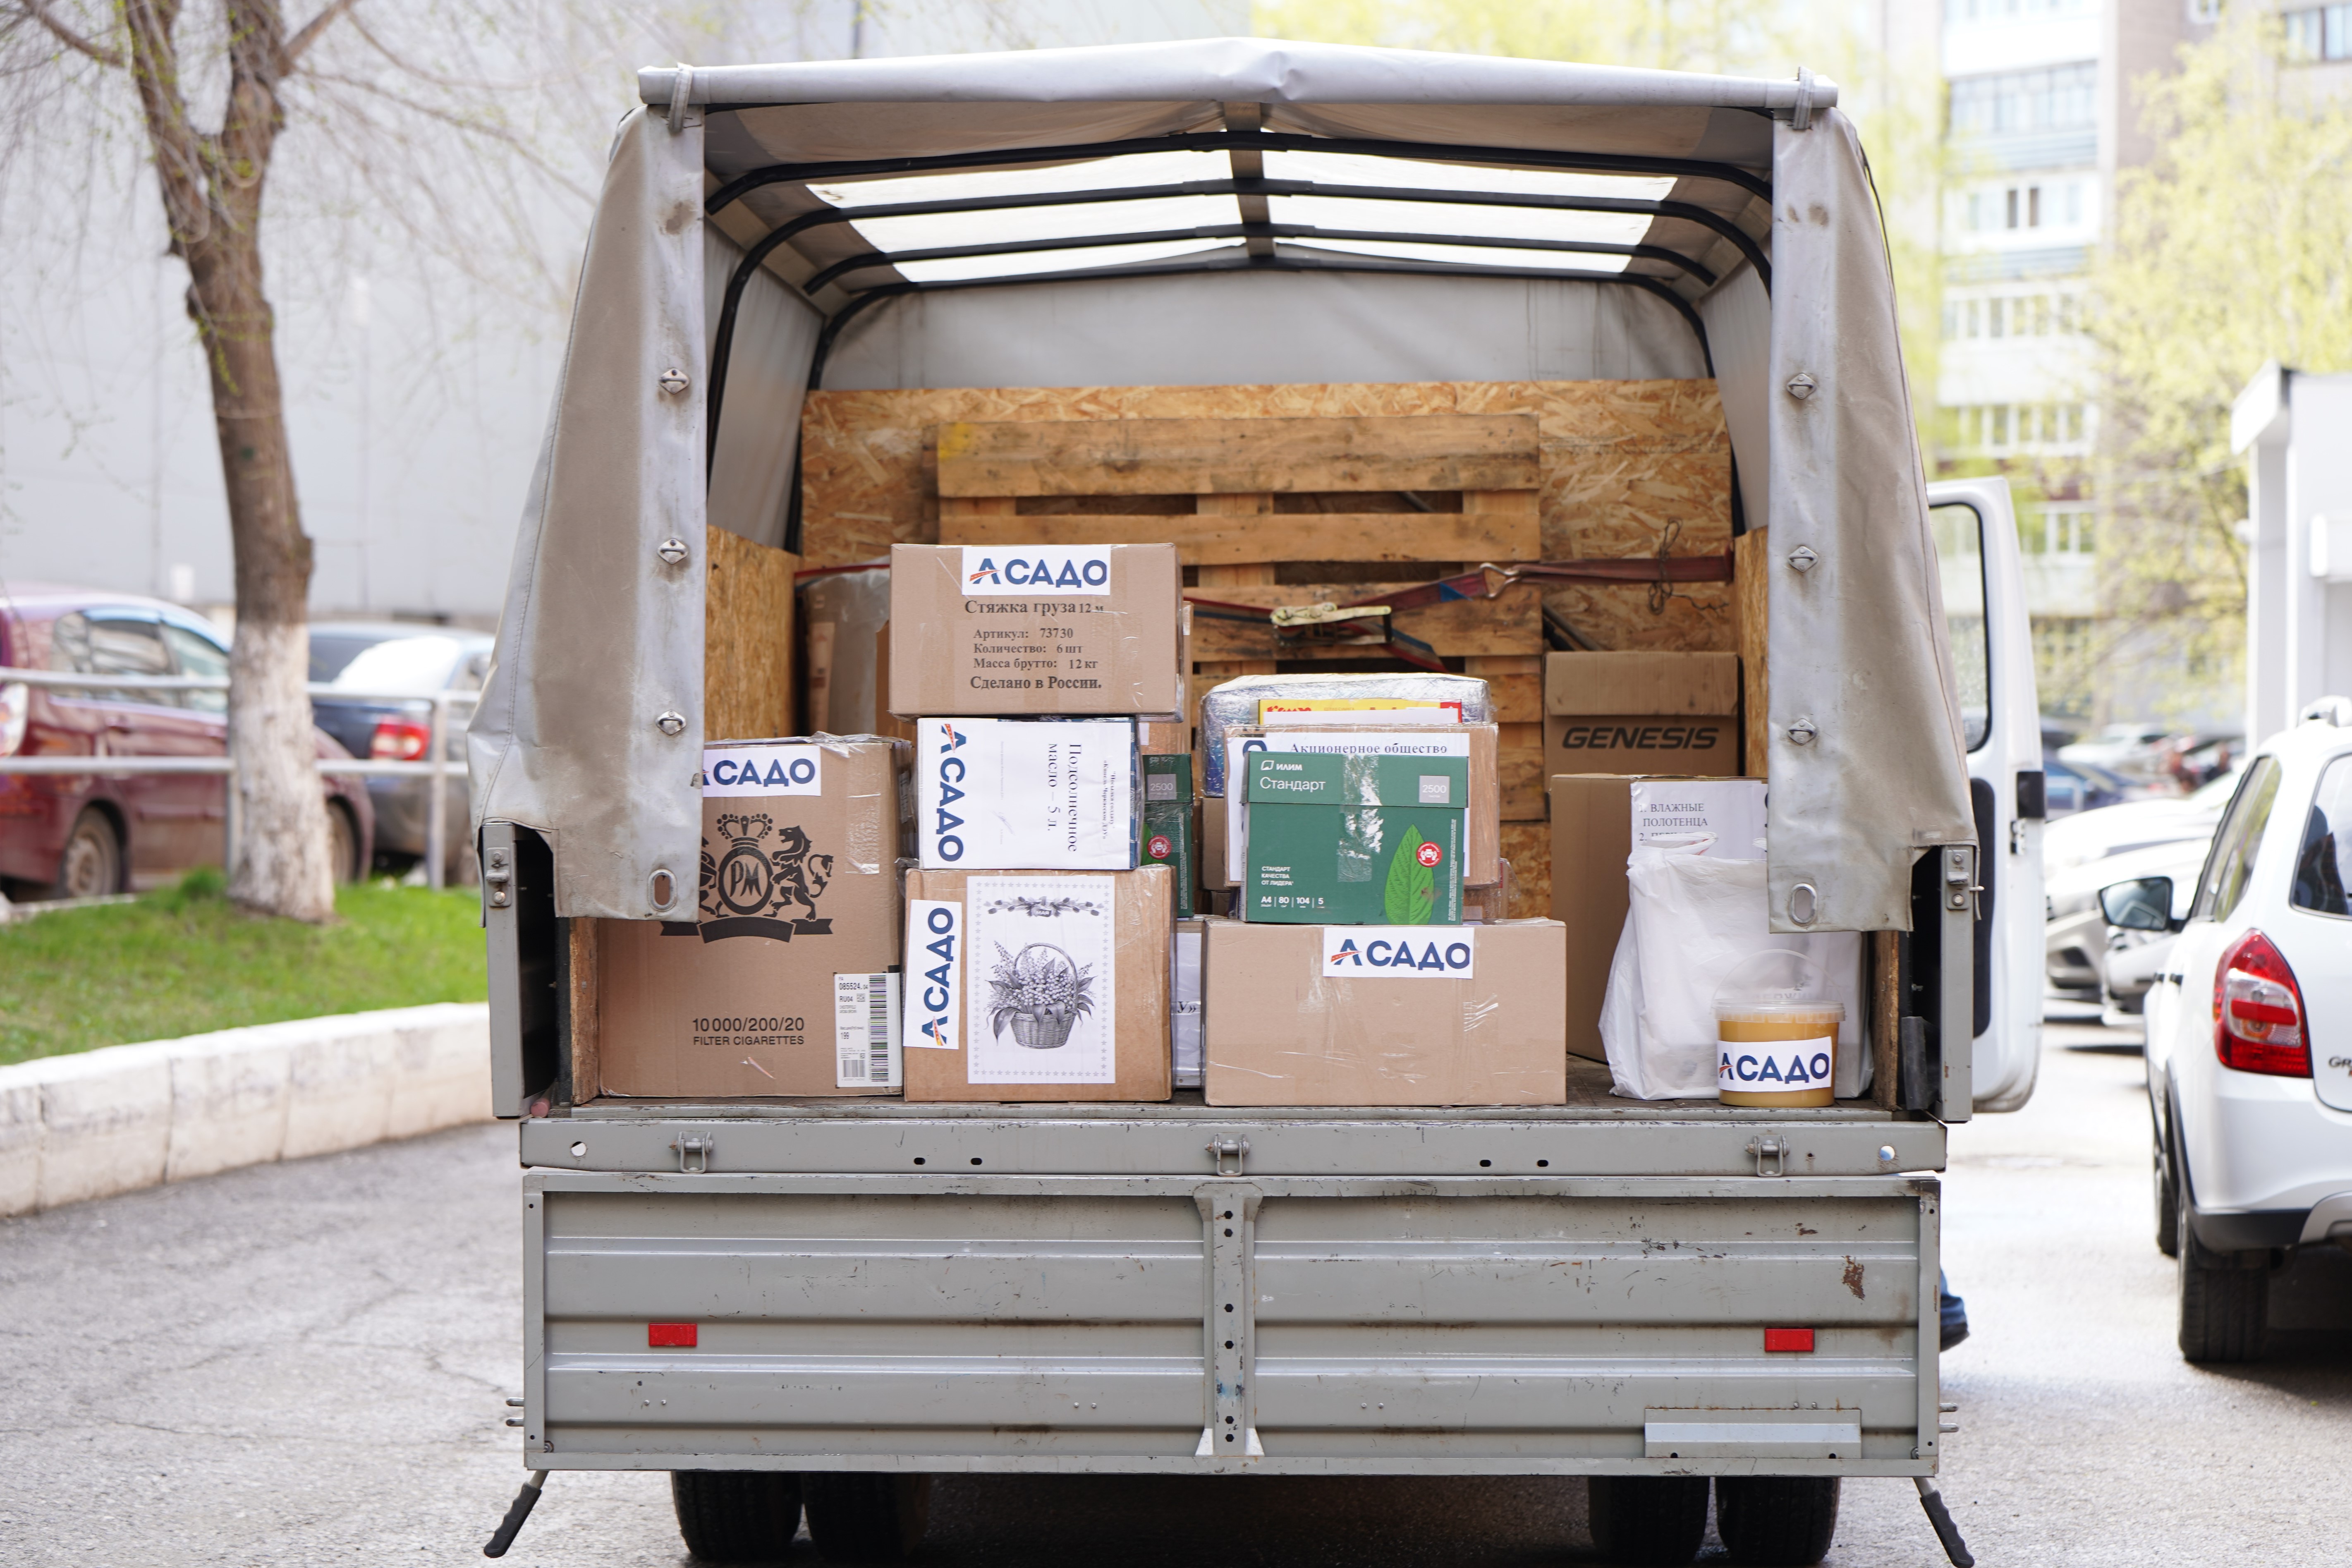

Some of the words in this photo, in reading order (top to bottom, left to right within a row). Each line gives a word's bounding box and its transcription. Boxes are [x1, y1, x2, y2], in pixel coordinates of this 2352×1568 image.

[969, 558, 1107, 588] АСАДО
[964, 600, 1028, 613] Стяжка
[1033, 603, 1076, 617] груза
[1079, 603, 1092, 613] 12
[973, 628, 1029, 640] Артикул:
[1039, 627, 1074, 639] 73730
[973, 643, 1046, 654] Количество:
[1056, 643, 1063, 654] 6
[973, 658, 1010, 668] Масса
[1013, 658, 1057, 671] брутто:
[1069, 658, 1082, 669] 12
[1084, 661, 1098, 669] кг
[970, 676, 1031, 689] Сделано
[1035, 679, 1043, 689] в
[1047, 675, 1102, 689] России.
[1562, 727, 1719, 749] GENESIS
[1290, 743, 1381, 753] Акционерное
[1384, 742, 1448, 755] общество
[703, 758, 815, 787] САДО
[1048, 744, 1058, 788] масло
[936, 723, 967, 862] АСАДО
[1150, 782, 1174, 791] 2500
[1260, 777, 1326, 793] Стандарт
[1422, 785, 1447, 794] 2500
[1067, 744, 1082, 852] Подсолнечное
[1651, 803, 1705, 812] ВЛАЖНЫЕ
[1643, 818, 1708, 828] ПОЛОТЕНЦА
[1639, 833, 1648, 841] 2.
[1330, 938, 1470, 971] АСАДО
[921, 907, 955, 1046] АСАДО
[693, 1036, 730, 1045] FILTER
[733, 1035, 804, 1045] CIGARETTES
[1718, 1053, 1830, 1084] АСАДО
